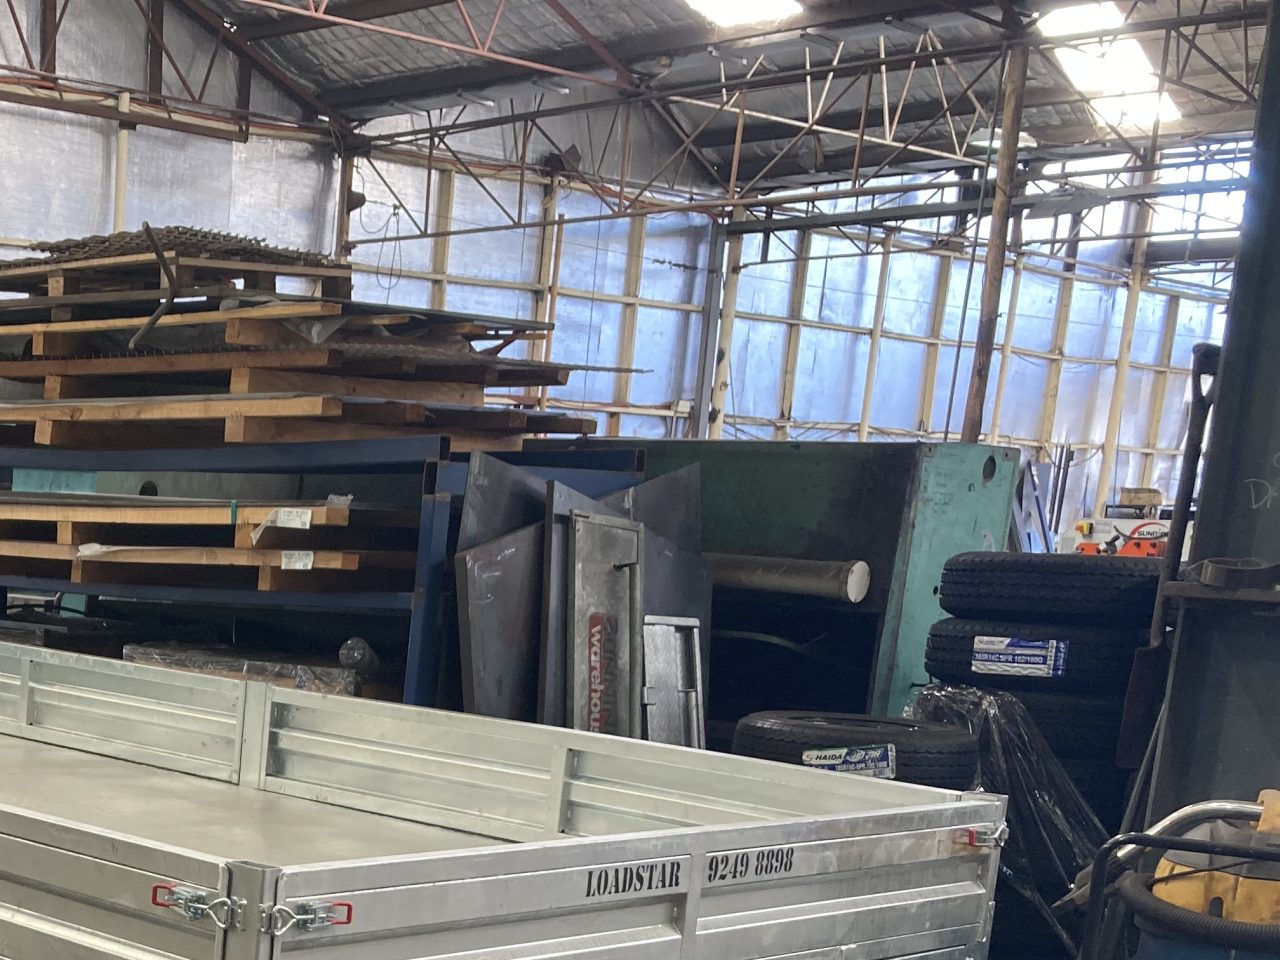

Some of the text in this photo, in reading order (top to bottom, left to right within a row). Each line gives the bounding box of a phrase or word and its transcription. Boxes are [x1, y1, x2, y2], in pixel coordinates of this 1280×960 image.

[585, 847, 794, 897] LOADSTAR 9249 8898
